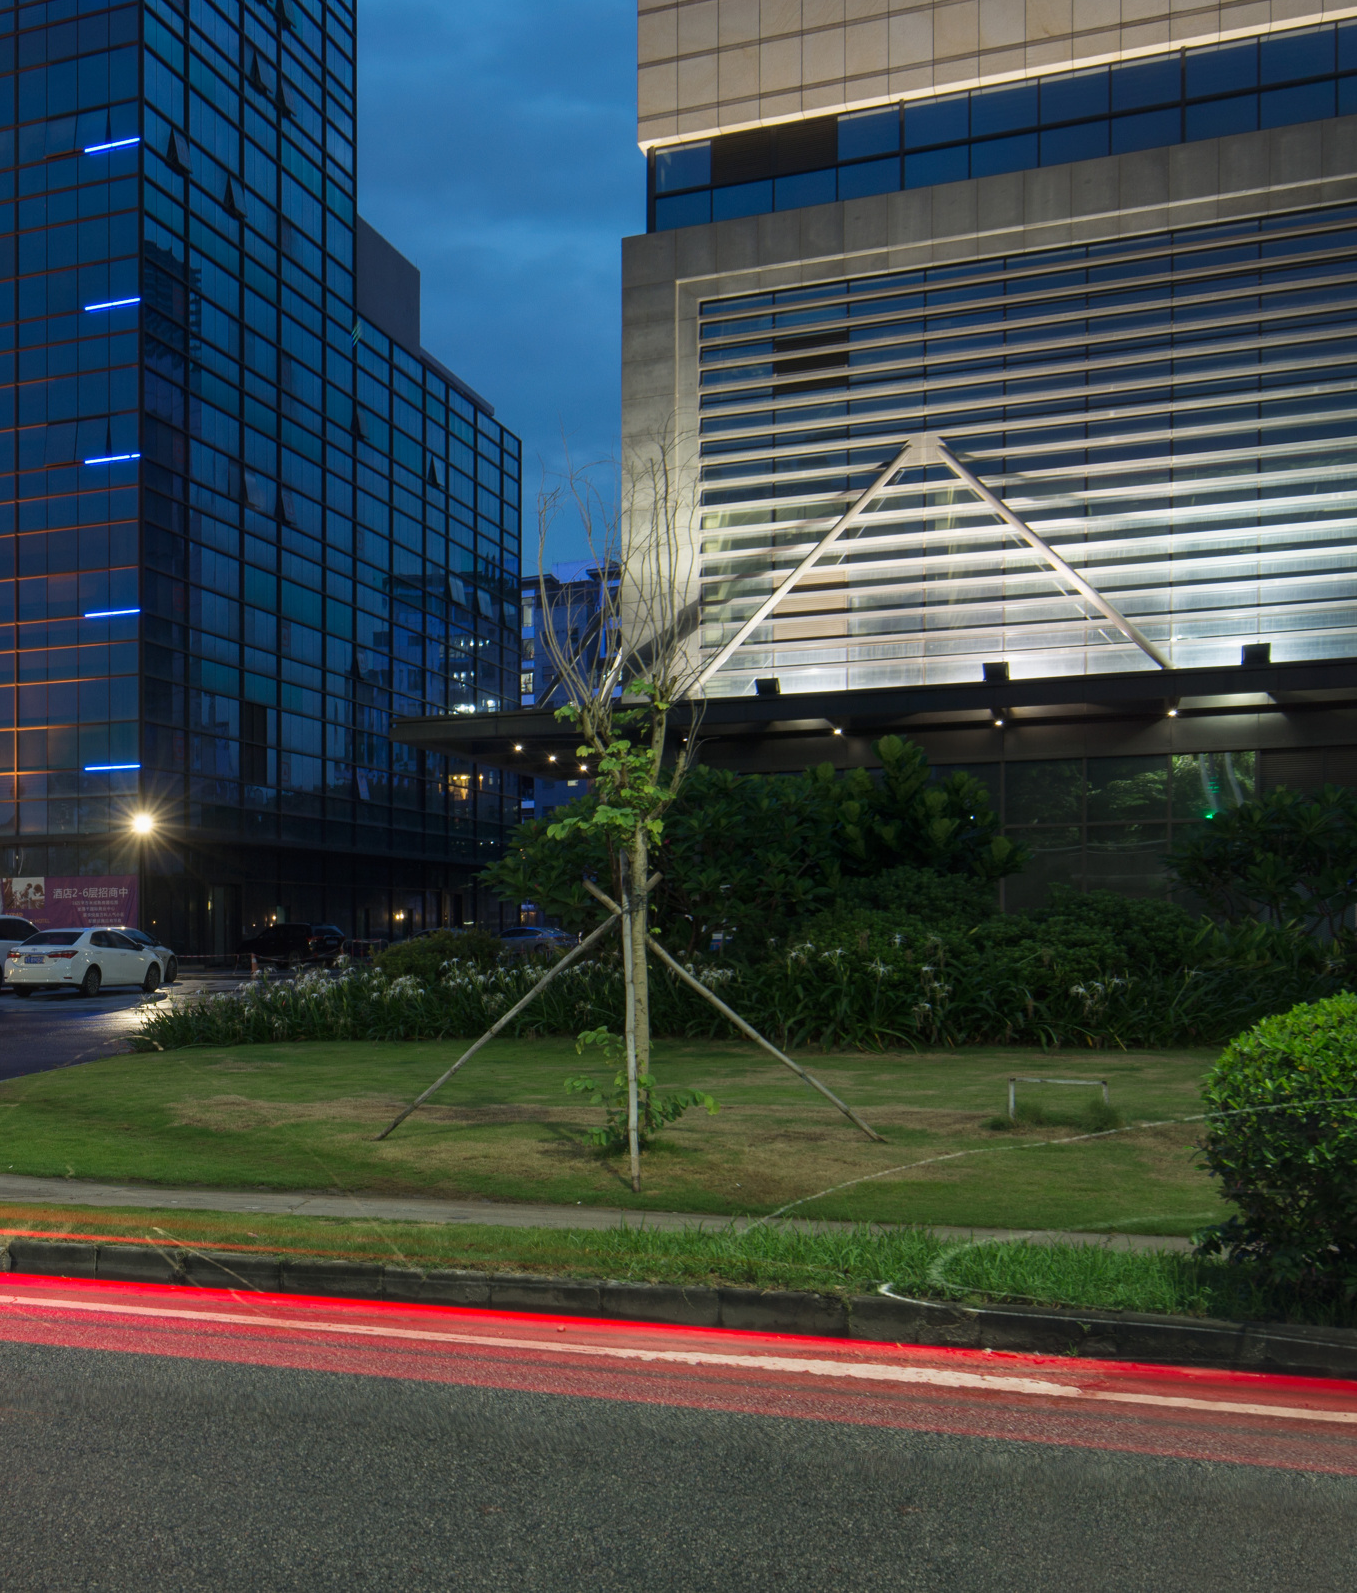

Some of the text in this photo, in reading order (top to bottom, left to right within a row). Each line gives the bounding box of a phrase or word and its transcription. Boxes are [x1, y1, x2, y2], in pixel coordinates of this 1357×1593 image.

[53, 887, 129, 899] 酒店2-6层招商中
